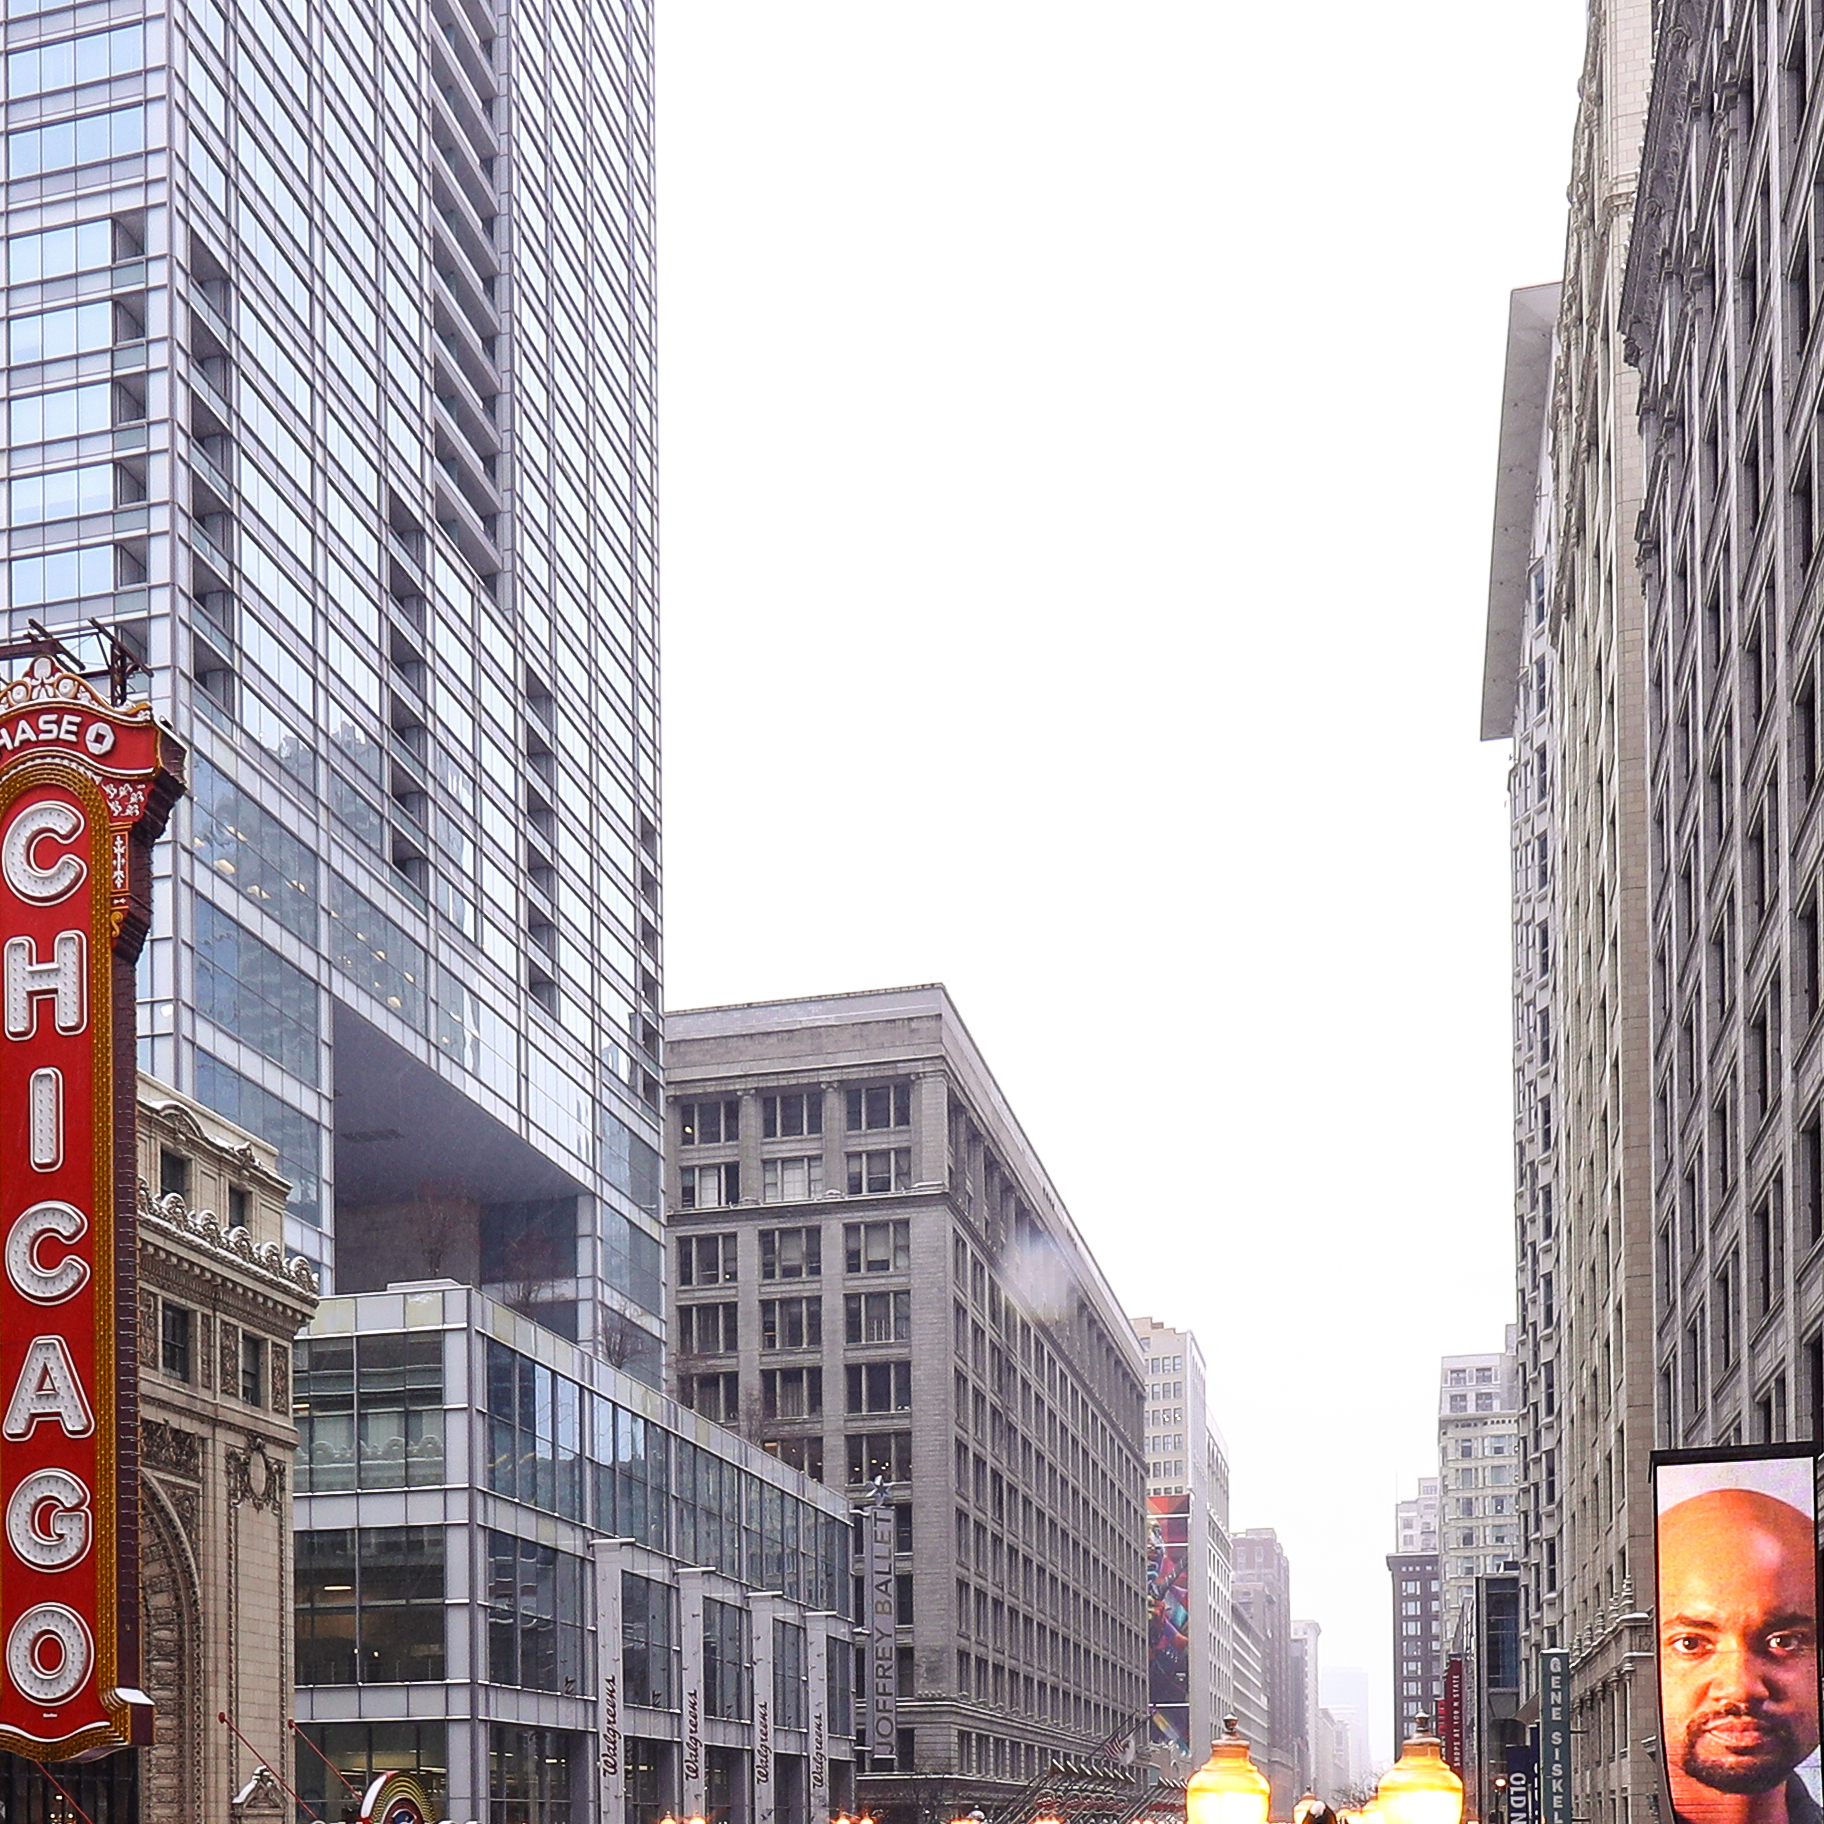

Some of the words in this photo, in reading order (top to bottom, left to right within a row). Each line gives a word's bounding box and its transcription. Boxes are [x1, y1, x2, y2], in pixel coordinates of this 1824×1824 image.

[0, 799, 95, 1709] CHICAGO
[874, 1511, 894, 1616] BALLET
[601, 1674, 622, 1778] Walgreens
[875, 1628, 894, 1756] JOFFREY
[1549, 1656, 1563, 1721] GENE
[684, 1689, 703, 1782] Walgreens
[756, 1701, 773, 1785] Walgreens
[812, 1712, 827, 1789] Walgreens
[1550, 1730, 1564, 1824] SISKEL
[1509, 1772, 1527, 1809] OLD
